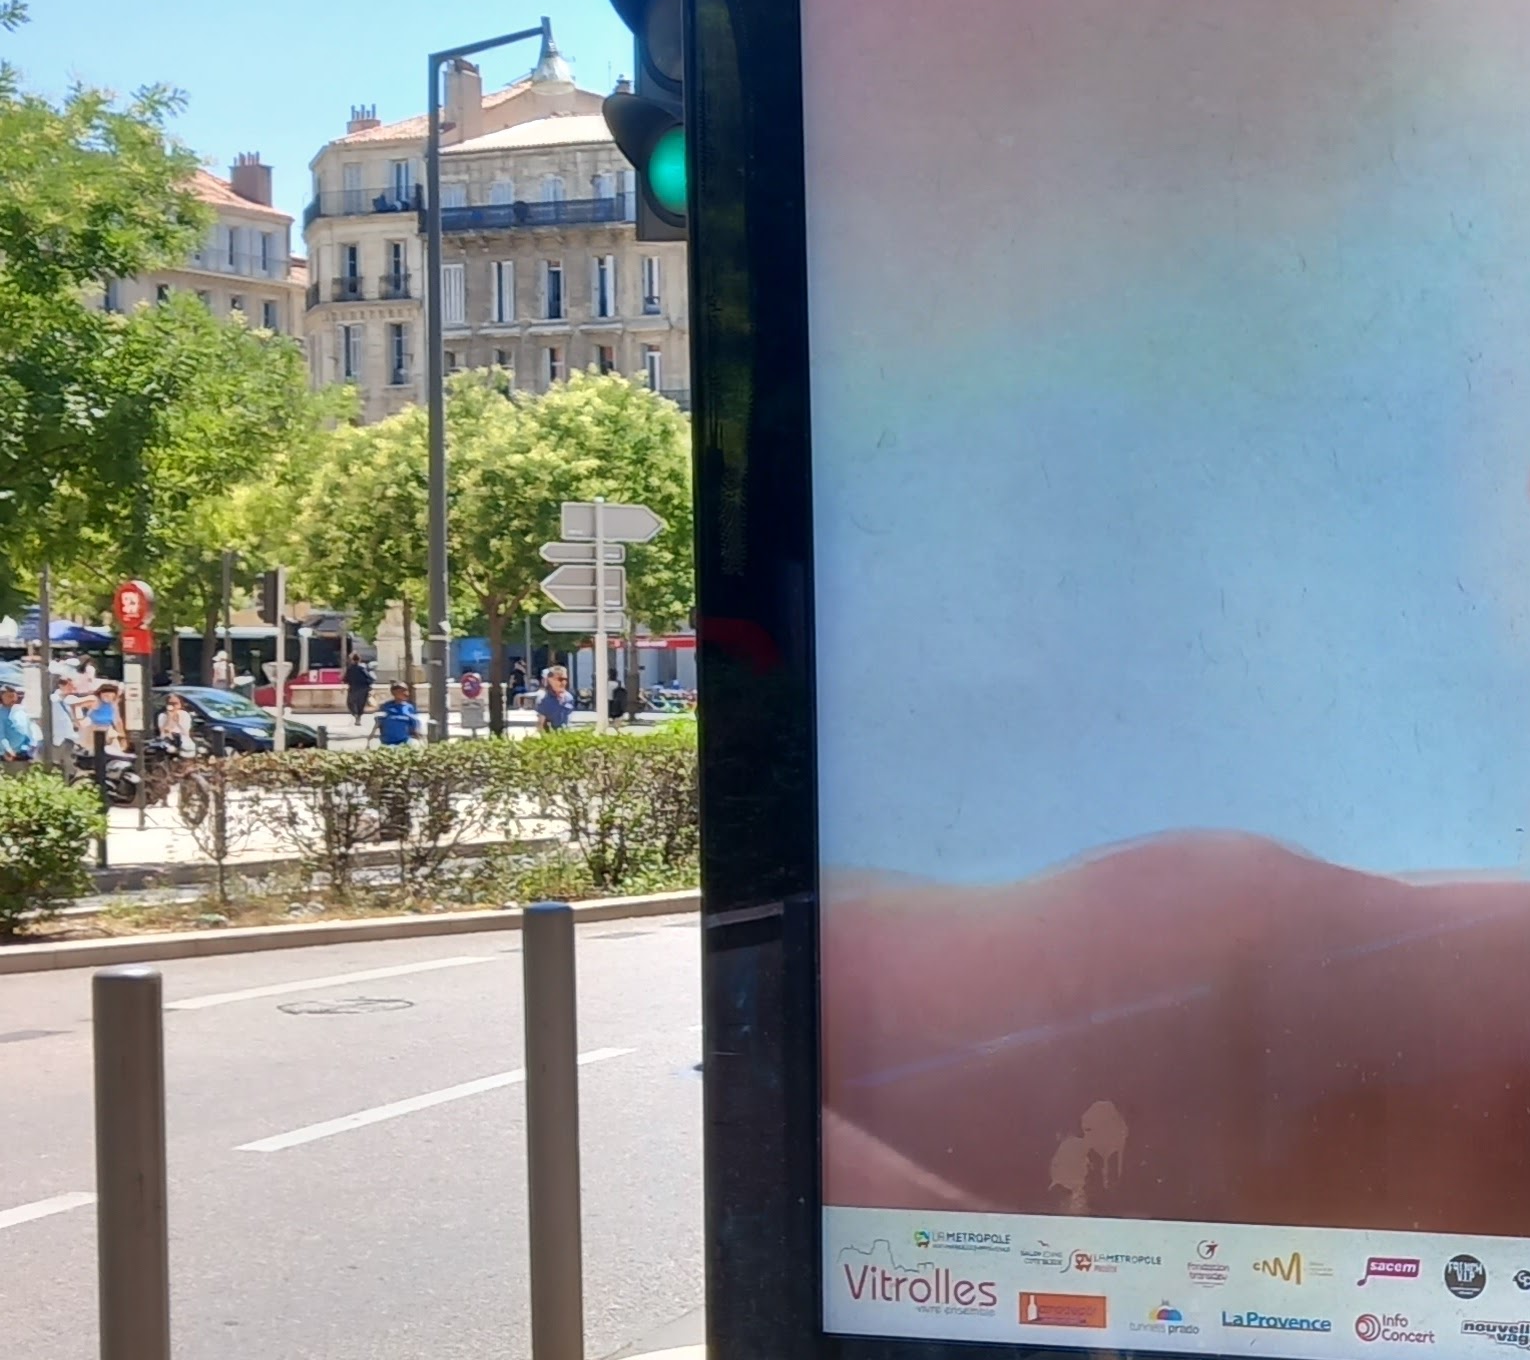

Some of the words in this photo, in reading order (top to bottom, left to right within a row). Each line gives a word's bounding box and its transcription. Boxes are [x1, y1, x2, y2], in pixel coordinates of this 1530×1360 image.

[1369, 1261, 1417, 1274] sacem
[843, 1263, 997, 1307] Vitrolles
[1382, 1314, 1409, 1328] Info
[1168, 1324, 1200, 1336] prado
[1382, 1328, 1436, 1344] Concert
